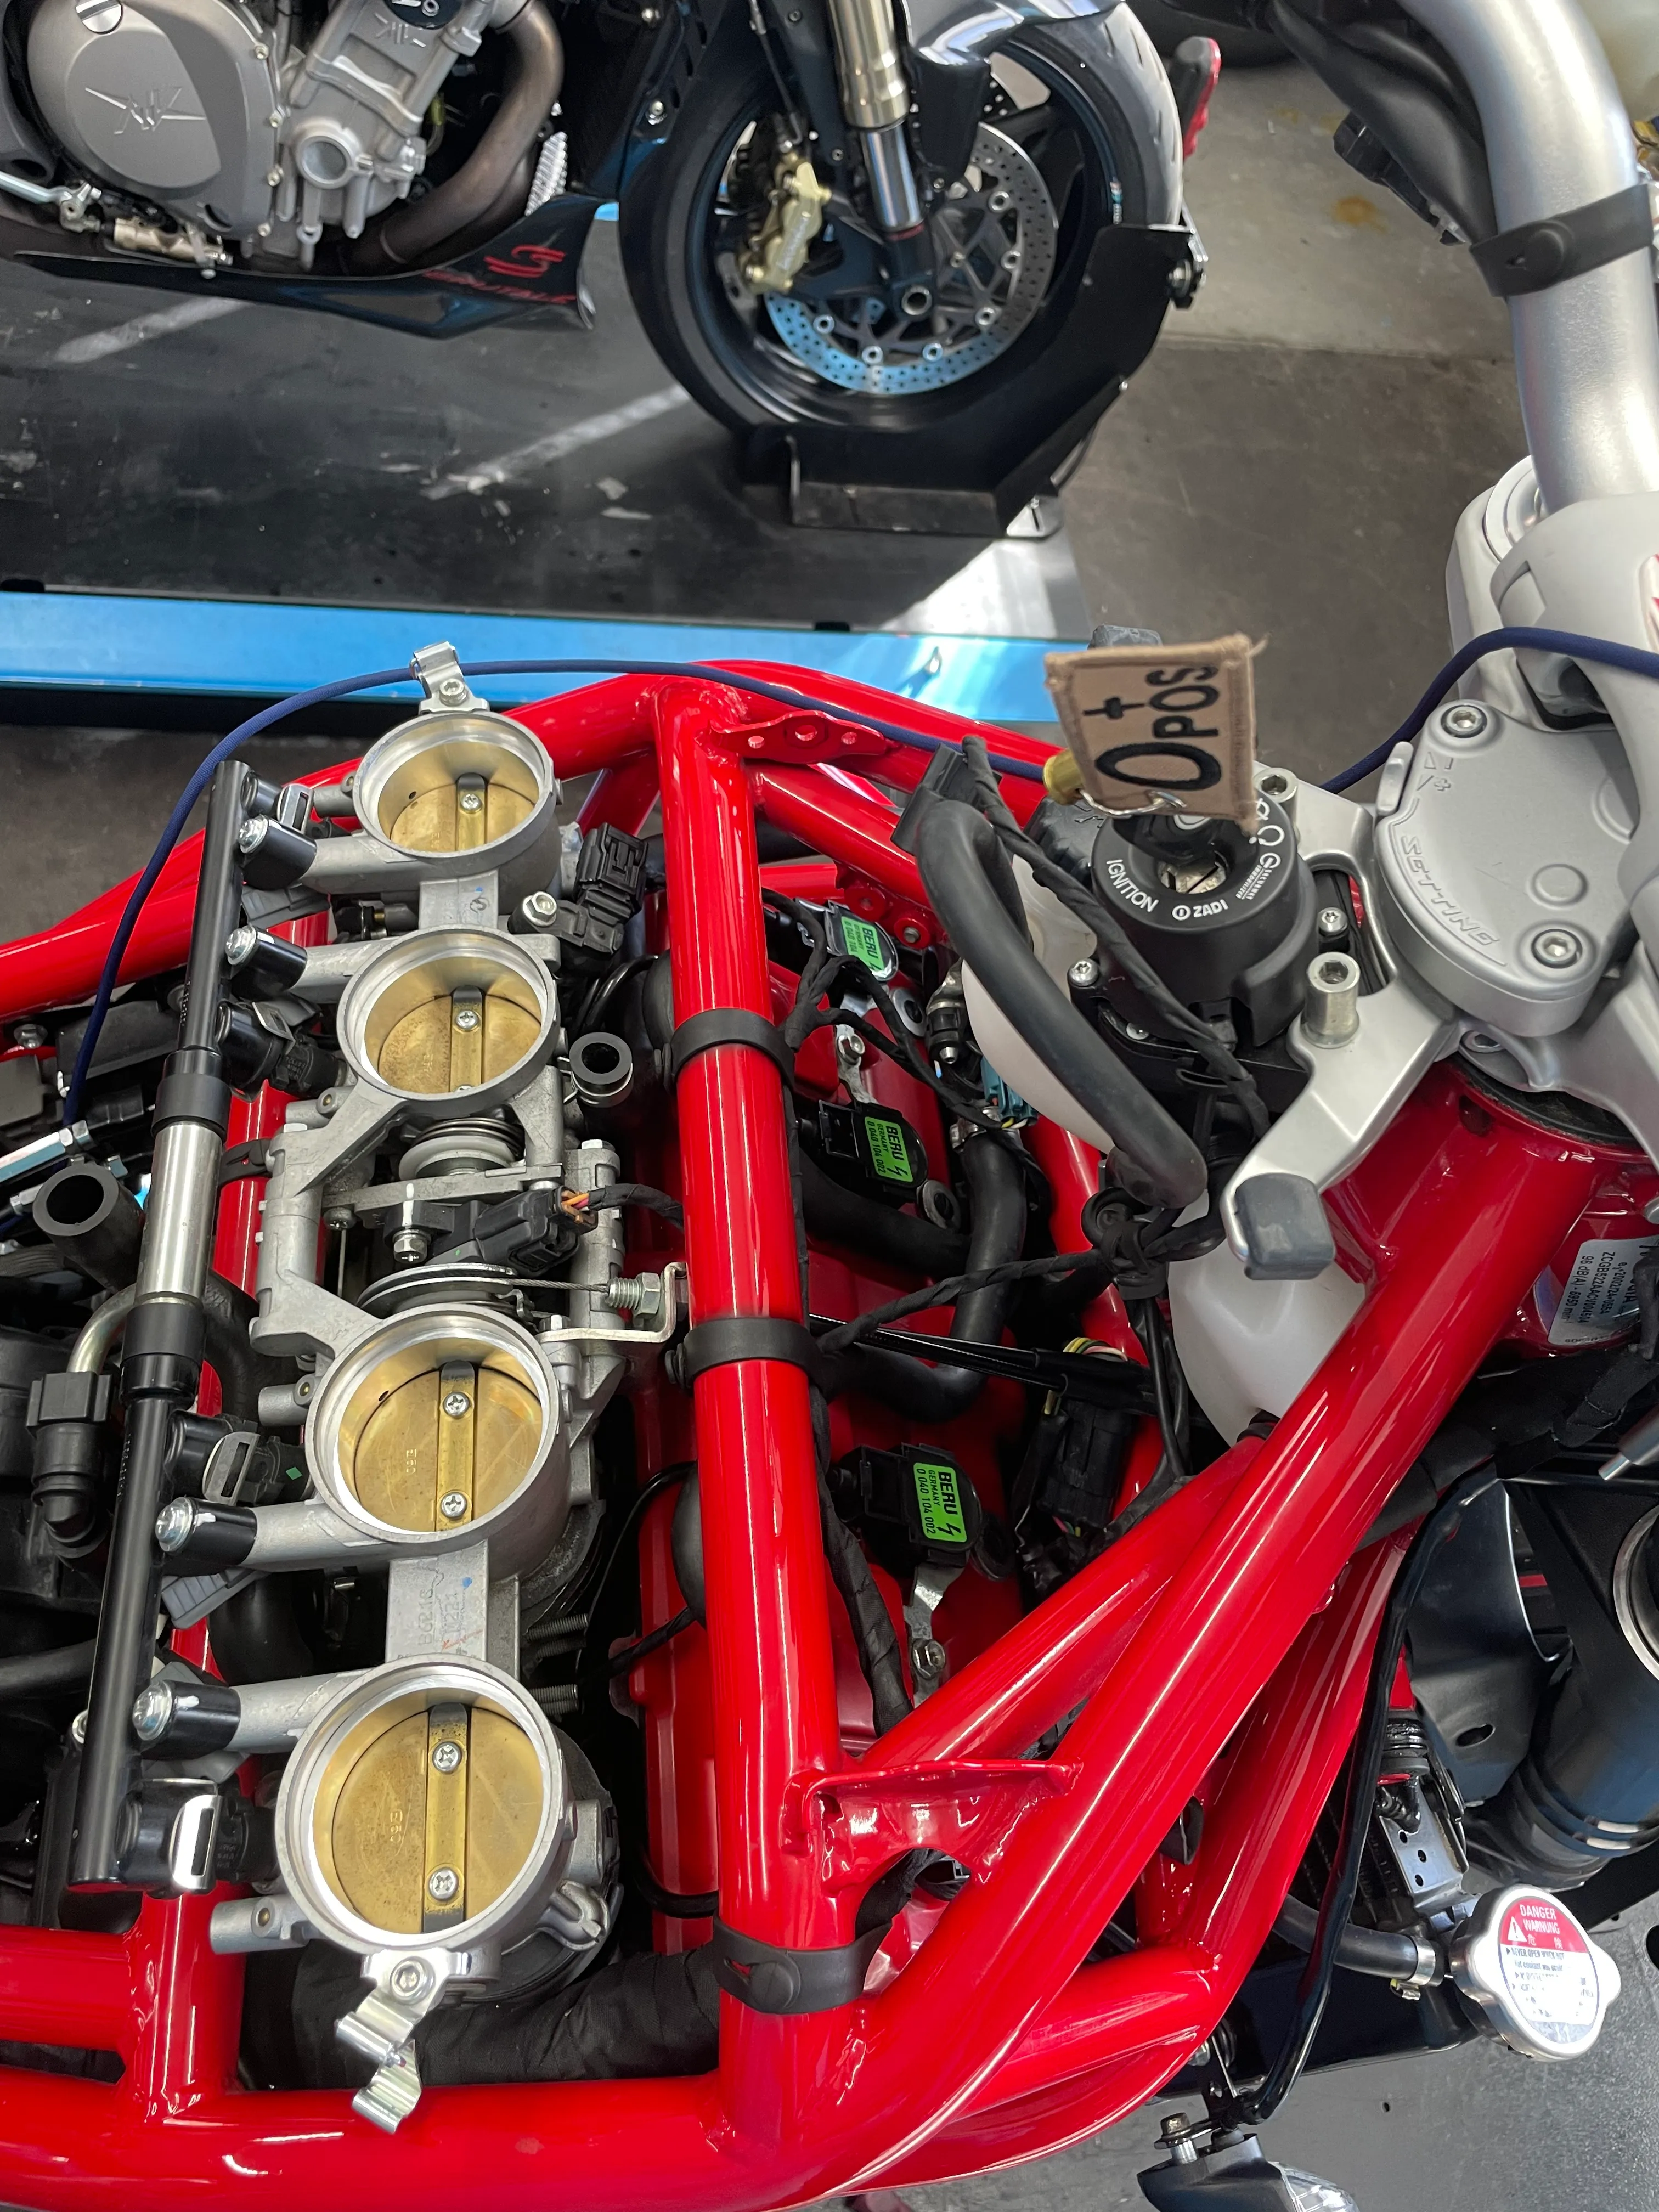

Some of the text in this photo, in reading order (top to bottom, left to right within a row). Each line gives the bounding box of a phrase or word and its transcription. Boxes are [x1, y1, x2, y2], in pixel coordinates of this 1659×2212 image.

[1106, 859, 1159, 913] IGNITION
[1401, 834, 1499, 947] SETTING
[1193, 899, 1229, 918] ZADI
[862, 928, 878, 958] BERU
[868, 1128, 879, 1141] 040
[877, 1124, 889, 1152] GERMANY
[872, 1144, 882, 1156] 104
[885, 1126, 905, 1160] BERU
[876, 1159, 887, 1173] 002
[1581, 1256, 1594, 1264] 96
[1571, 1266, 1590, 1285] dB(A)
[918, 1477, 929, 1493] 040
[928, 1470, 940, 1505] GERMANY
[938, 1472, 958, 1515] BERU
[922, 1498, 932, 1513] 104
[924, 1517, 936, 1533] 002
[1519, 1904, 1556, 1920] DANGER
[1523, 1920, 1560, 1934] WARNUNG
[1511, 1947, 1527, 1957] NEVER
